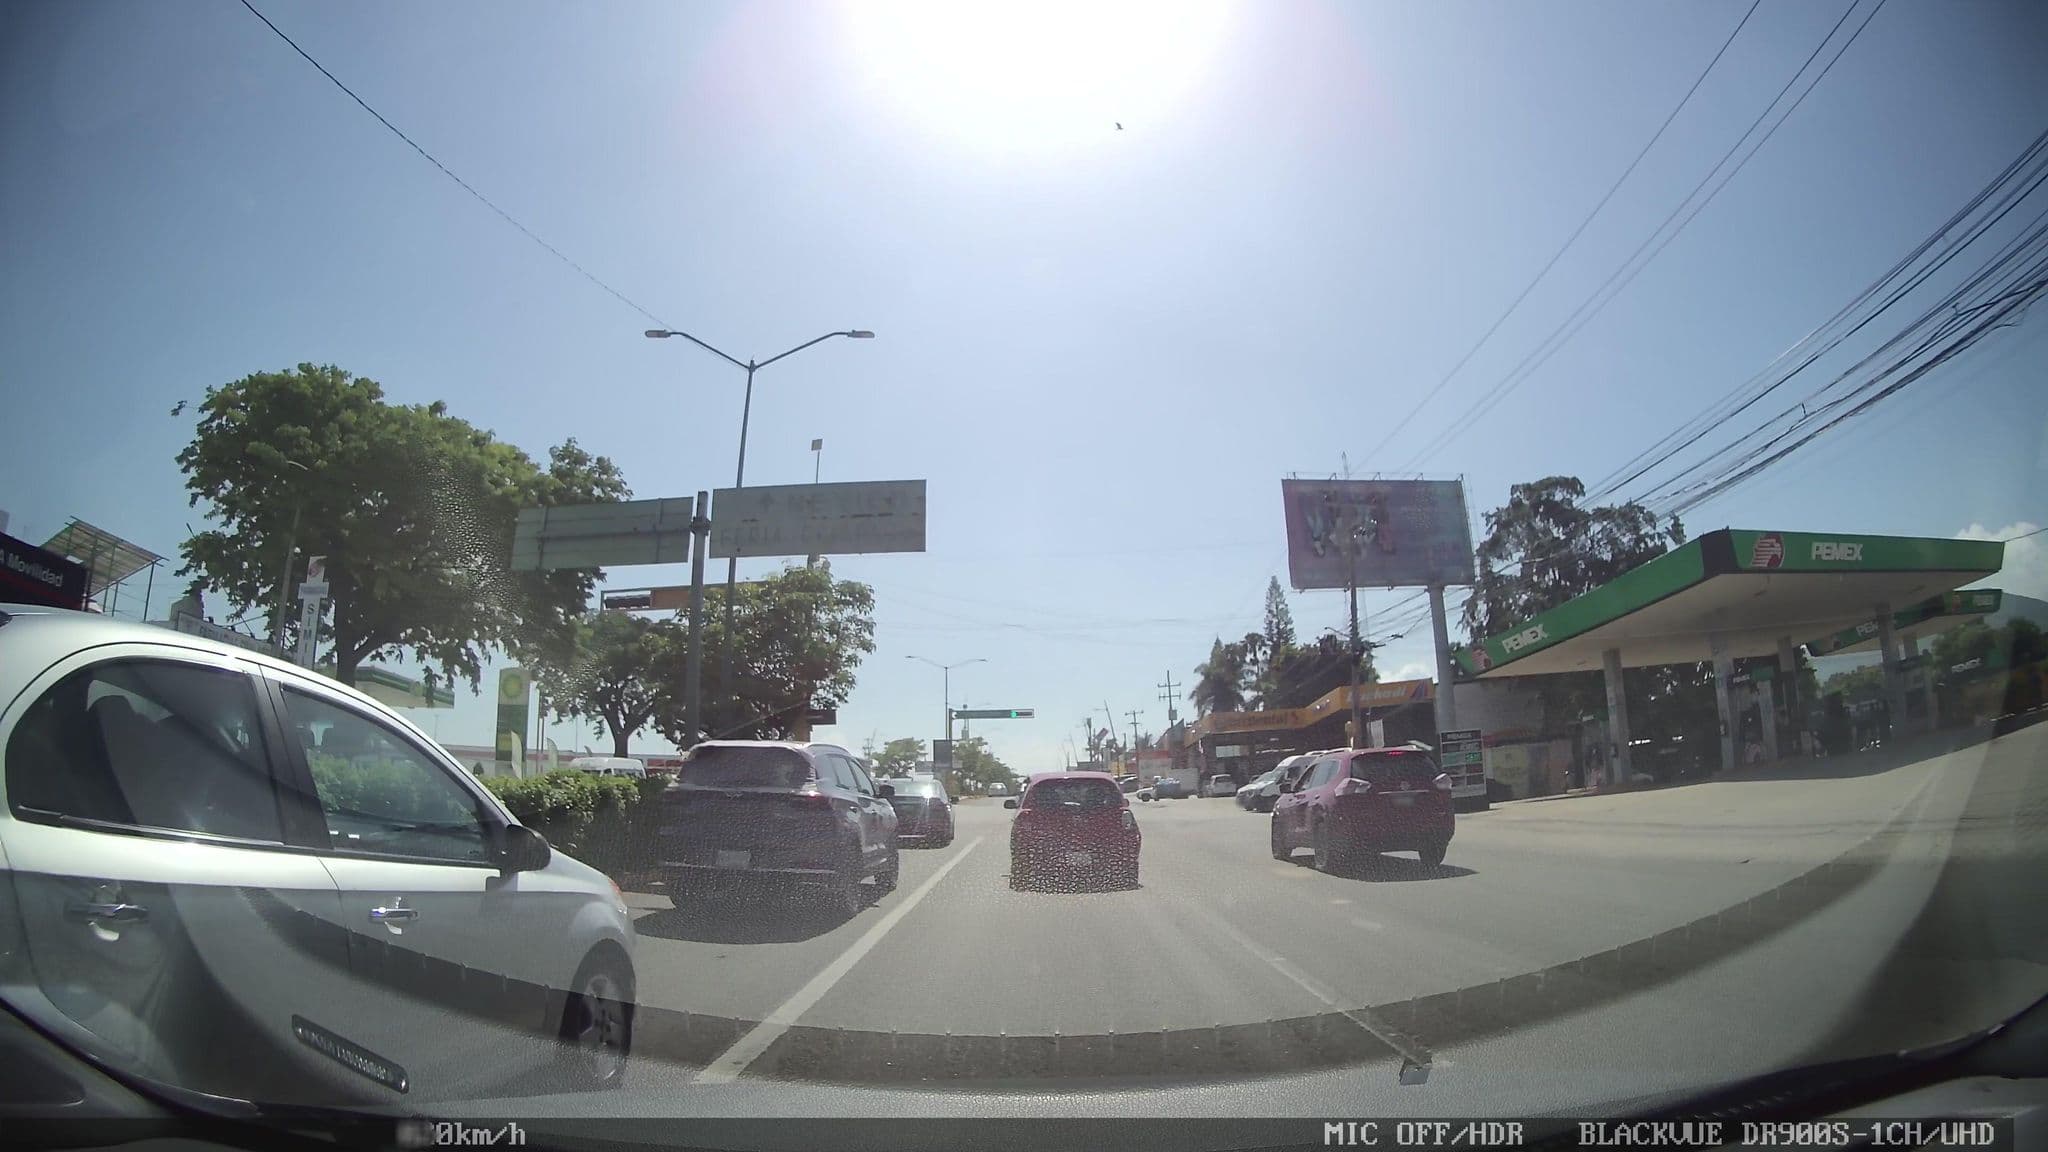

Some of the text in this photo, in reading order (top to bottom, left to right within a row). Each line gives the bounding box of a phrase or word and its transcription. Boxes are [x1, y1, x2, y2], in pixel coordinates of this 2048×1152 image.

[1811, 542, 1863, 561] PEMEX
[8, 553, 64, 587] Movilidad
[1502, 624, 1548, 654] PEMEX
